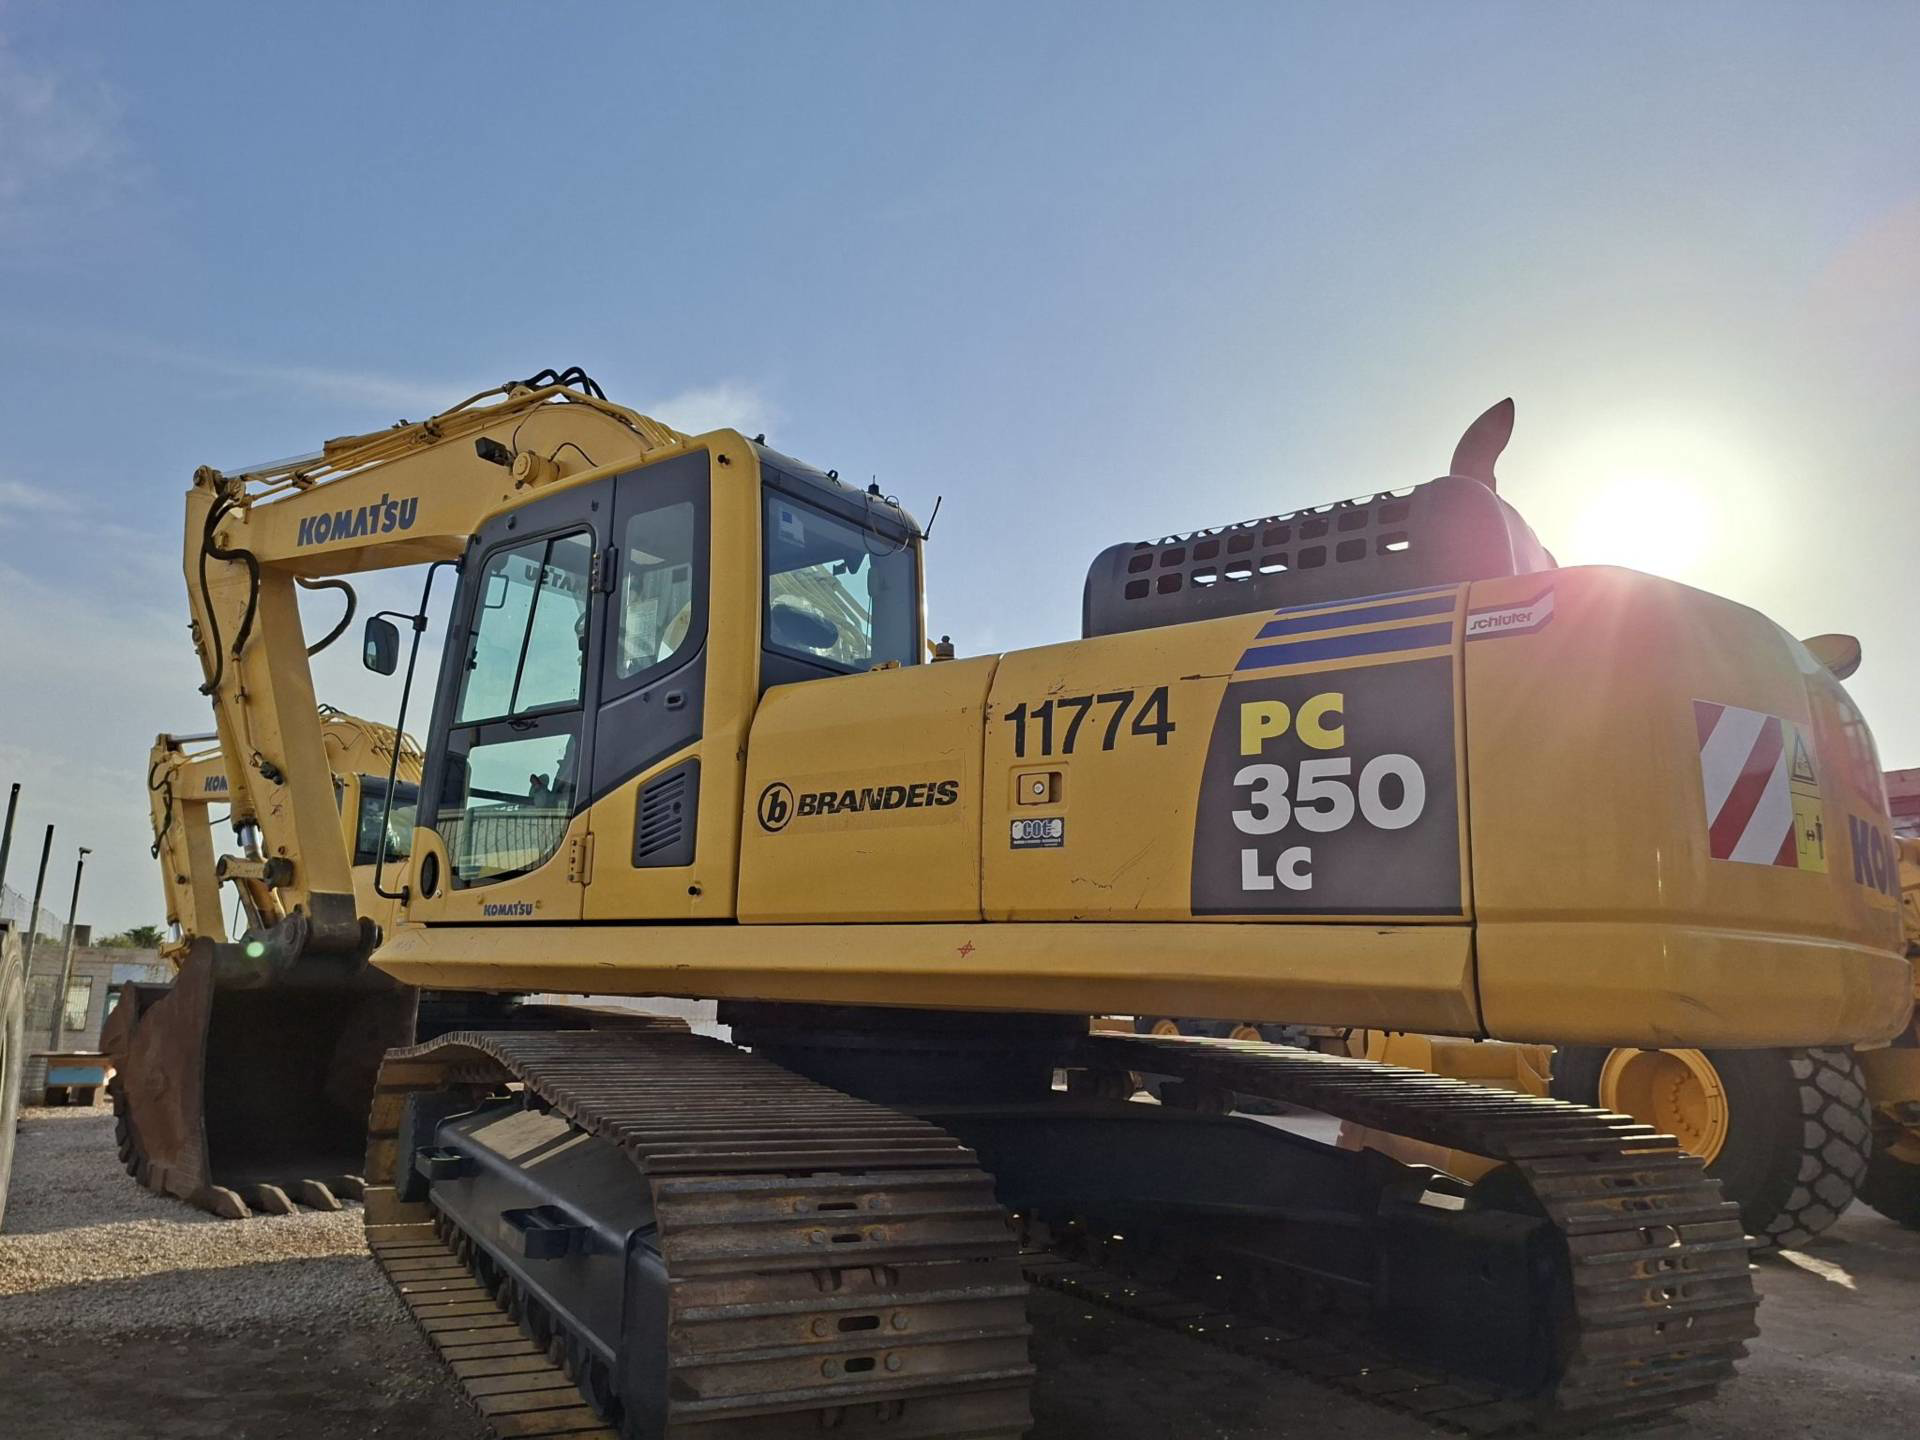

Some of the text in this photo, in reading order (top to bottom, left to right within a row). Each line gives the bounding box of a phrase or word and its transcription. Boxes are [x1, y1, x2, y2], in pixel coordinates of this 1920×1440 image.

[297, 493, 418, 547] KOMATSU
[1004, 685, 1176, 757] 11774
[1240, 692, 1345, 756] PC
[1231, 753, 1426, 835] 350
[1241, 846, 1313, 891] LC
[483, 899, 533, 917] KOMATSU
